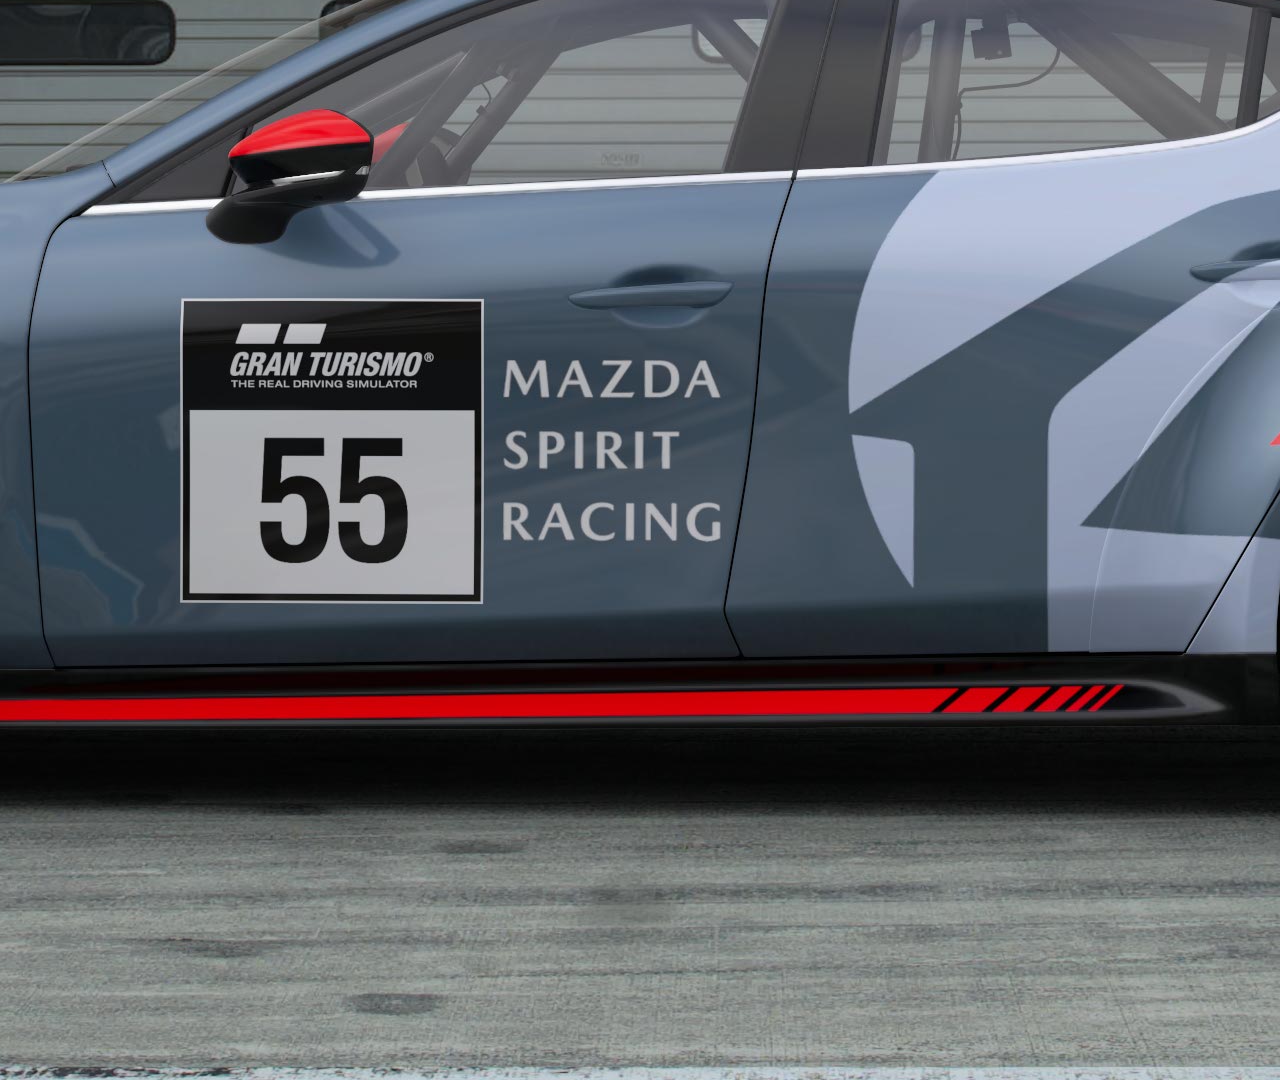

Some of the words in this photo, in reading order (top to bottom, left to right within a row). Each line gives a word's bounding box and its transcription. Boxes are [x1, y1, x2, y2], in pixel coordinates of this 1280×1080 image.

[230, 351, 303, 377] GRAN
[502, 359, 721, 398] MAZDA
[231, 379, 255, 389] THE
[258, 379, 290, 389] REAL
[293, 379, 343, 389] DRIVING
[346, 379, 418, 389] SIMULATOR
[503, 430, 680, 470] SPIRIT
[259, 437, 409, 564] 55
[502, 502, 721, 542] RACING
